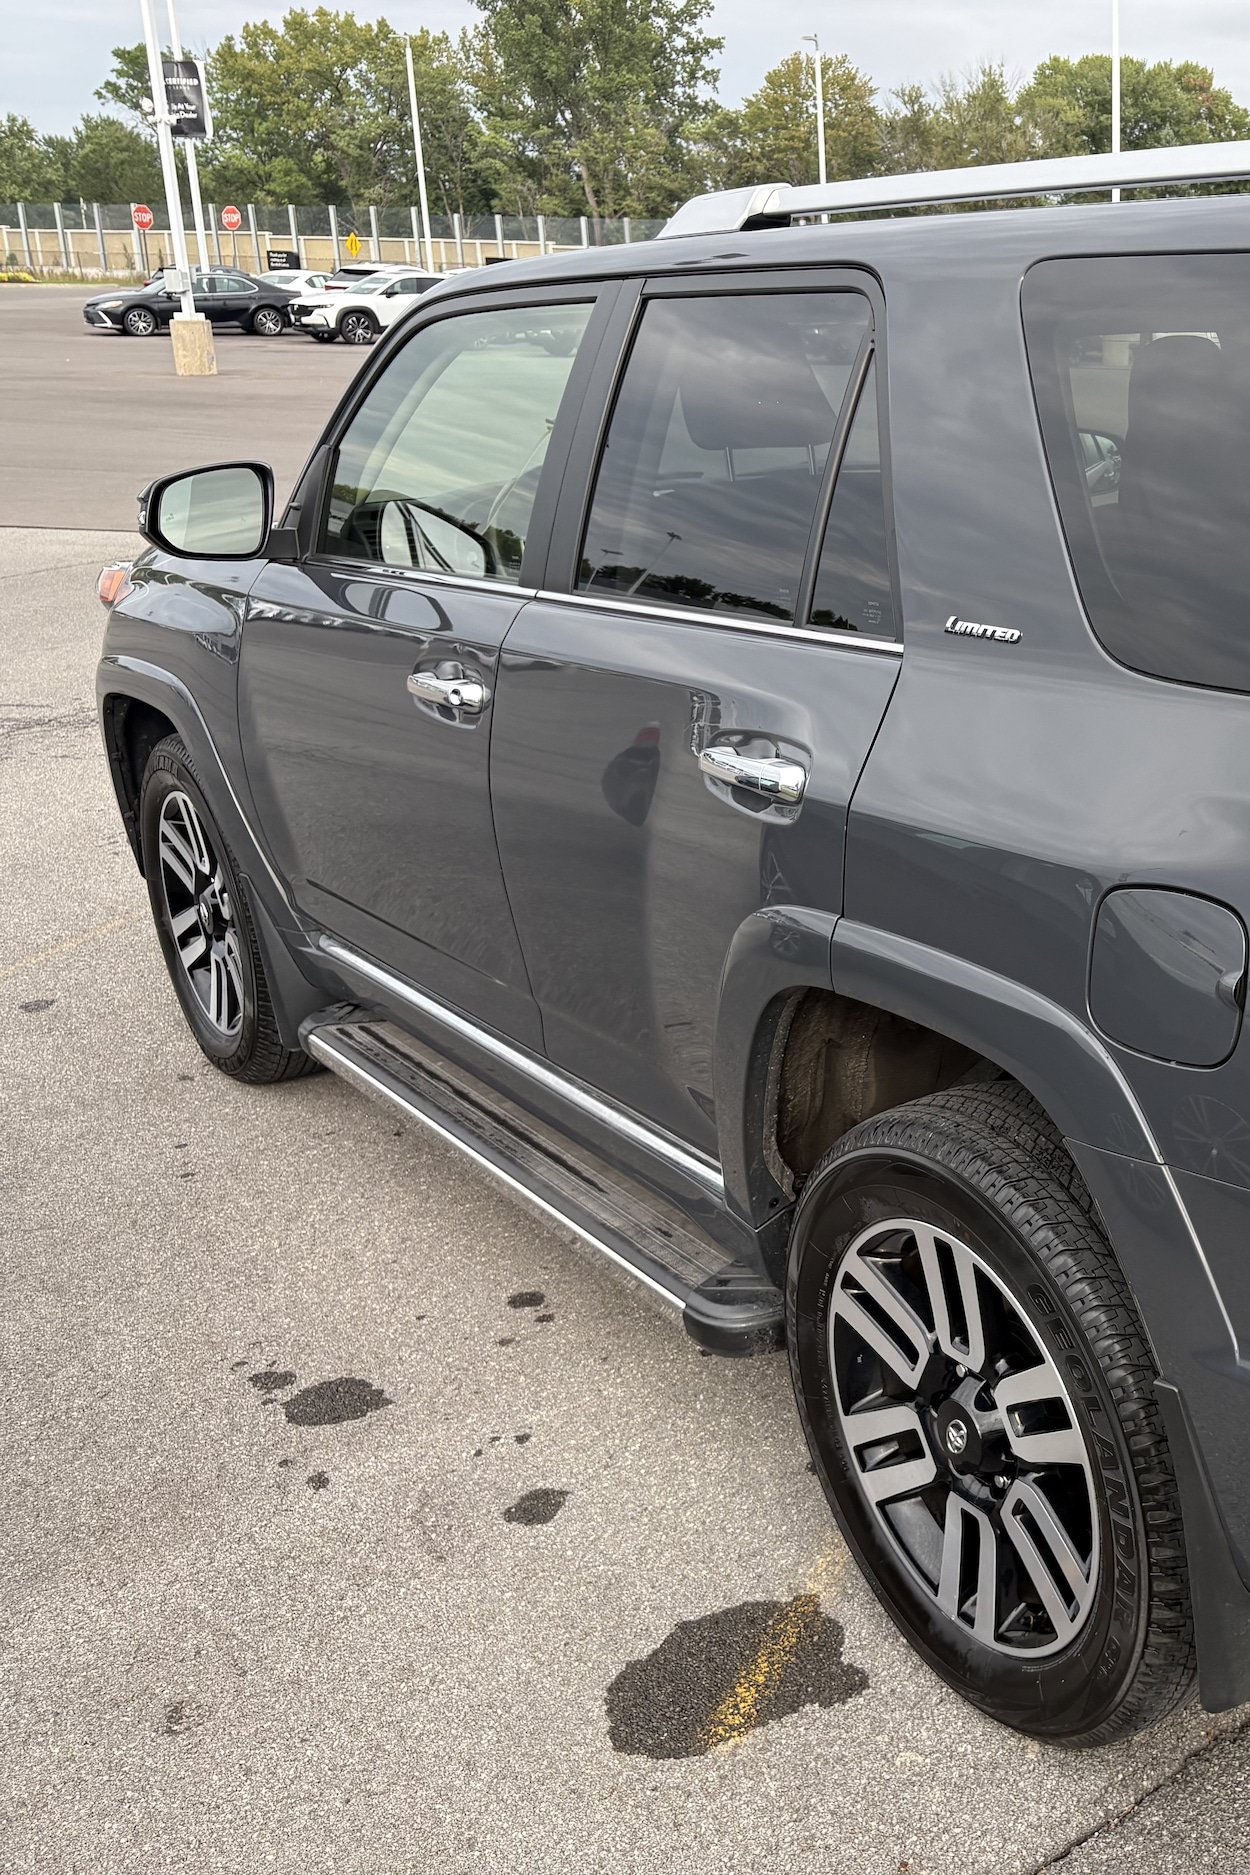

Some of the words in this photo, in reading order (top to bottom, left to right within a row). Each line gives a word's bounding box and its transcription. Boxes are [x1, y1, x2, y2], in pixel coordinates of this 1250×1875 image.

[134, 212, 152, 223] STOP
[223, 213, 240, 223] STOP
[1026, 1281, 1137, 1632] GEOLANDAR
